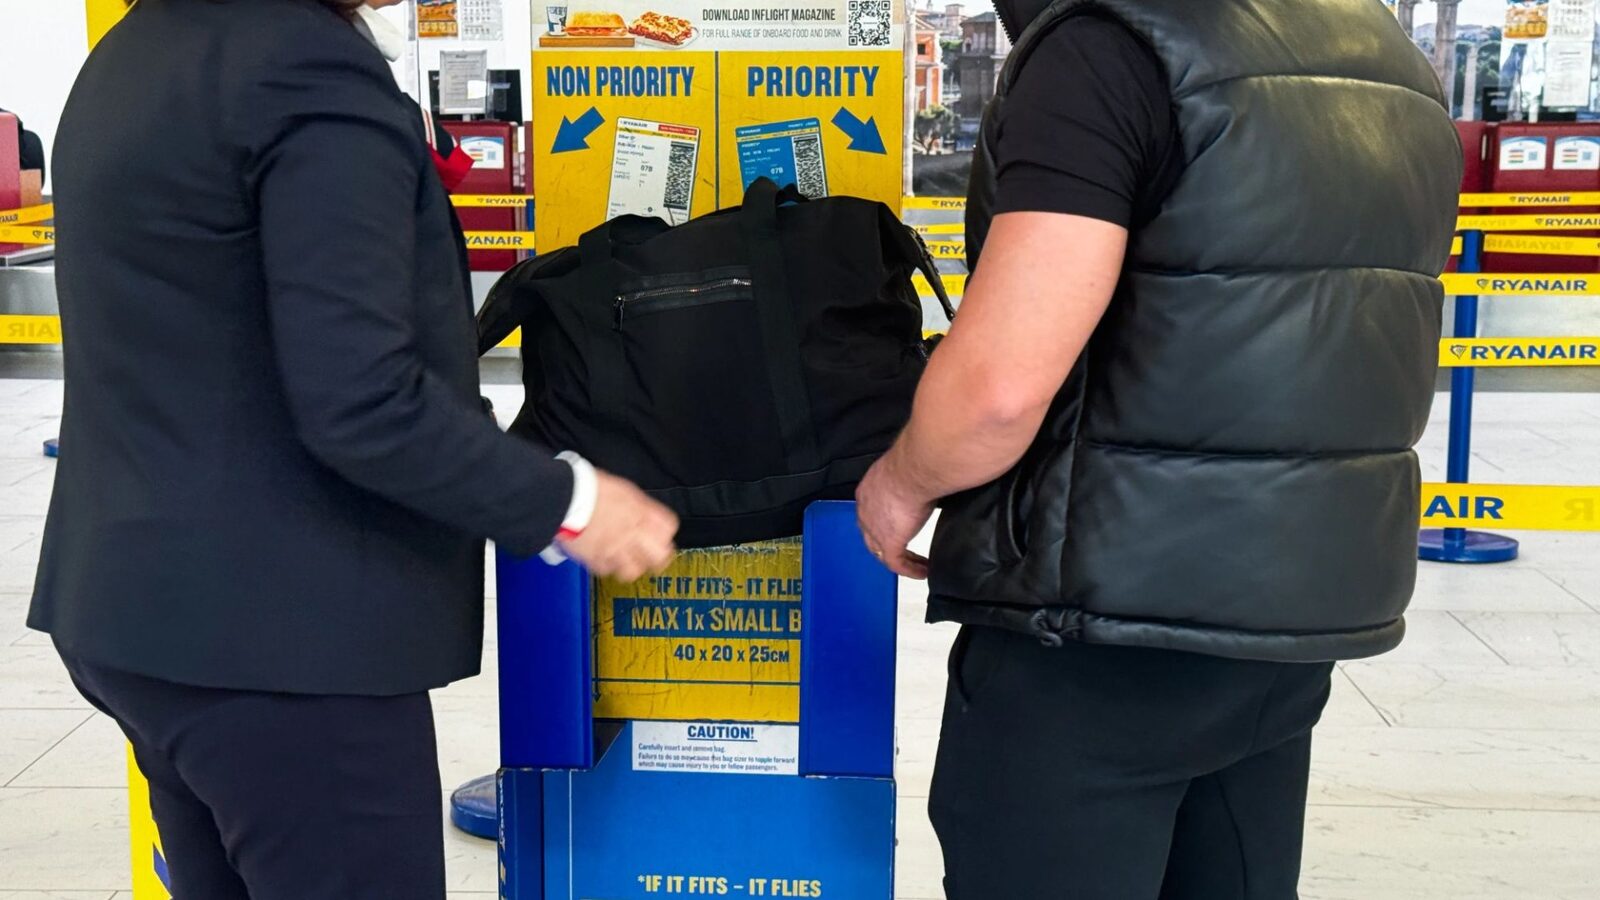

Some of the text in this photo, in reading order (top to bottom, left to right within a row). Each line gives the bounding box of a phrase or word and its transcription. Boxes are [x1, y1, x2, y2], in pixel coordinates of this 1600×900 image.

[702, 8, 836, 21] DOWNLOAD INFLIGHT MAGAZINE
[702, 28, 842, 38] FOR FULL RANGE OF ONBOARD FOOD AND DRINK
[546, 65, 695, 97] NON PRIORITY
[747, 65, 880, 98] PRIORITY
[1518, 196, 1571, 204] RYANAIR
[1545, 218, 1600, 226] RYANAI
[1492, 280, 1587, 291] RYANAIR
[1470, 345, 1597, 359] RYANAIR
[1423, 495, 1504, 520] AIR
[676, 577, 693, 594] IT
[696, 577, 733, 595] FITS
[747, 578, 763, 595] IT
[631, 606, 679, 630] MAX
[709, 607, 784, 633] SMALL
[674, 644, 695, 661] 40
[711, 645, 732, 662] 20
[687, 725, 755, 740] CAUTION!
[638, 743, 664, 752] Carefully
[638, 752, 657, 760] Failure
[722, 755, 733, 763] bag
[755, 756, 772, 764] topple
[666, 875, 685, 893] IT
[688, 876, 729, 895] FITS
[749, 878, 767, 895] IT
[771, 878, 822, 897] FLIES
